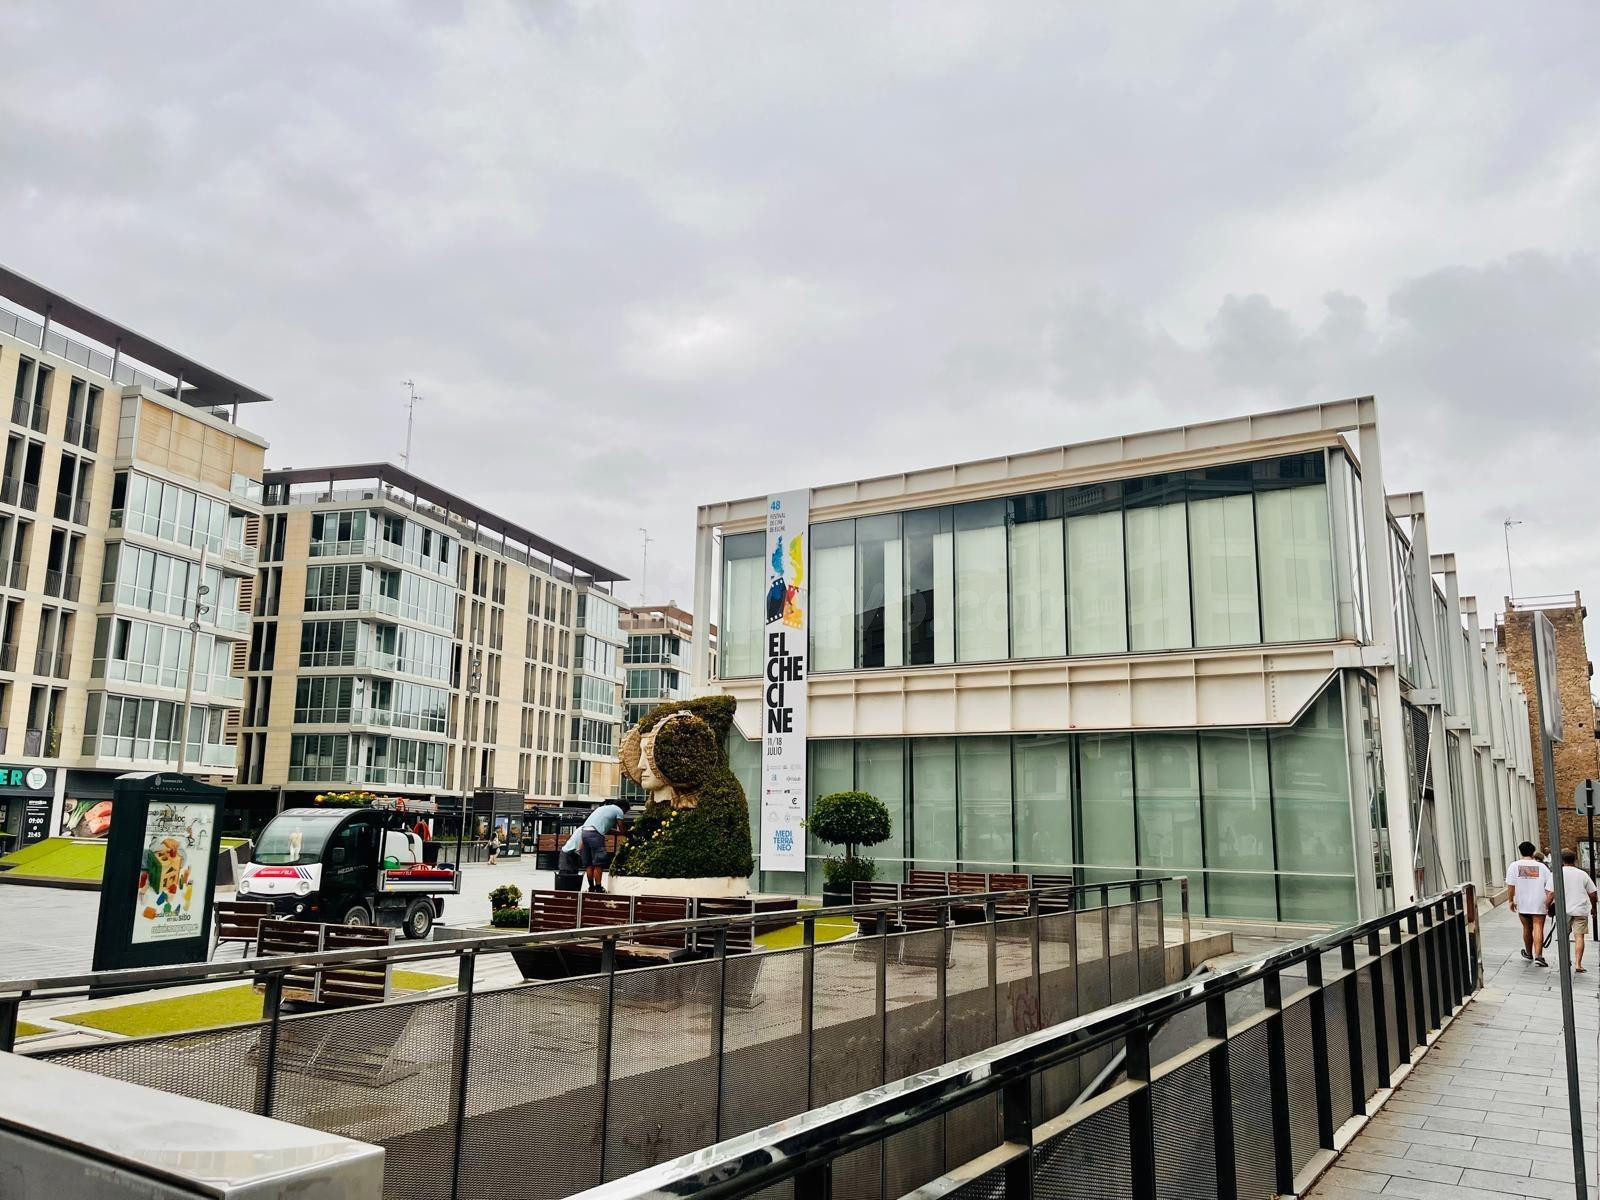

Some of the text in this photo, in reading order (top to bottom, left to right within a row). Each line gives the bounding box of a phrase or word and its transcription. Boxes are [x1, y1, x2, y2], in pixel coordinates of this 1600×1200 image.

[770, 500, 781, 510] 48
[769, 632, 789, 657] EL
[767, 656, 803, 683] CHE
[766, 683, 784, 709] CI
[768, 707, 793, 734] NE
[767, 737, 783, 746] 11/18
[767, 746, 782, 756] JULIO
[775, 830, 793, 838] MEDI
[773, 837, 794, 845] TERRA
[178, 913, 191, 922] sitio
